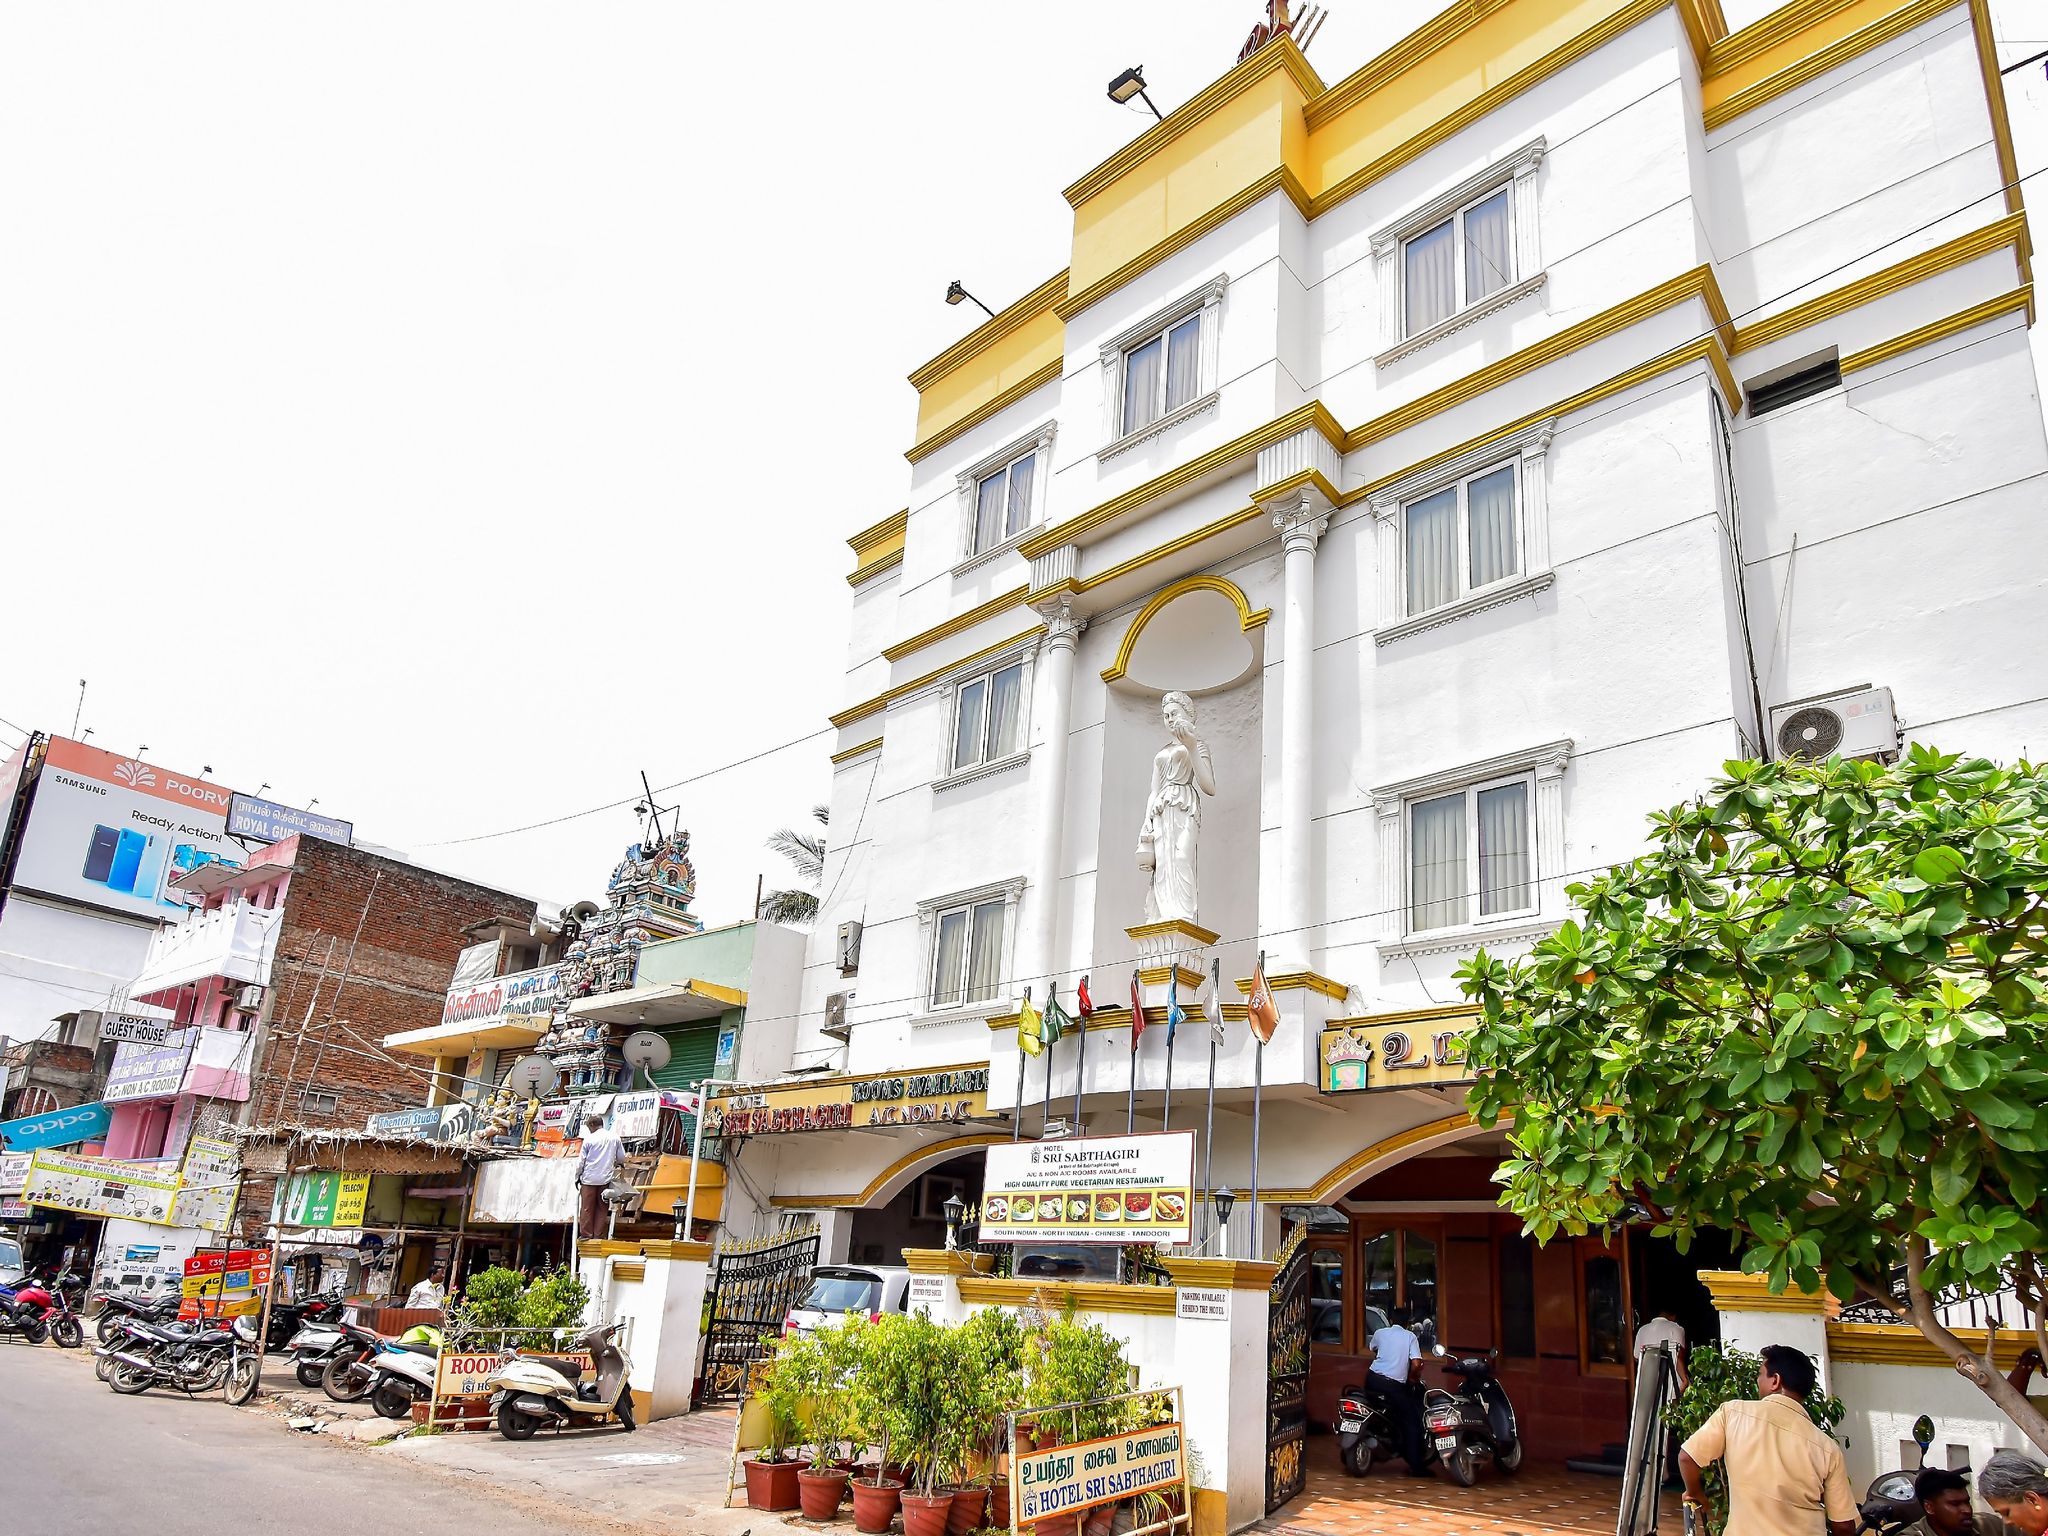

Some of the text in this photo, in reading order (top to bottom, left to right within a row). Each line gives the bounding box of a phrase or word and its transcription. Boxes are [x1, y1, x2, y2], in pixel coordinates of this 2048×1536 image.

[55, 775, 107, 796] SAMSUNG
[165, 778, 229, 807] POORV
[131, 809, 223, 843] Ready, Action!
[235, 816, 269, 836] ROYAL
[119, 1015, 155, 1027] ROYAL
[105, 1021, 165, 1042] GUEST HOUSE
[851, 1068, 990, 1103] ROOMS AVAILABLE
[639, 1097, 655, 1111] DTH
[728, 1093, 770, 1111] HOTEL
[868, 1099, 972, 1125] A/C NON A/C
[378, 1110, 439, 1129] Thentral Studio
[723, 1103, 853, 1135] SRI SABTHAGIRI
[1042, 1149, 1140, 1164] SRI SABTHAGIRI
[59, 1161, 92, 1171] CRESCENT
[93, 1164, 115, 1175] WATCH
[124, 1170, 138, 1178] GIFT
[140, 1172, 158, 1181] SHOP
[147, 1181, 175, 1191] SERVICE
[342, 1183, 364, 1193] TELECOM
[1021, 1180, 1049, 1188] QUALITY
[1050, 1179, 1068, 1187] PURE
[1070, 1178, 1114, 1186] VEGETARIAN
[1115, 1176, 1164, 1185] RESTAURANT
[1181, 1292, 1225, 1303] PARKING AVAILABLE
[1182, 1304, 1224, 1315] BEHIND THE HOTEL
[1022, 1432, 1179, 1486] உயர்தர சைவ உணவகம்
[1039, 1459, 1177, 1513] HOTEL SRI SABTHAGIRI
